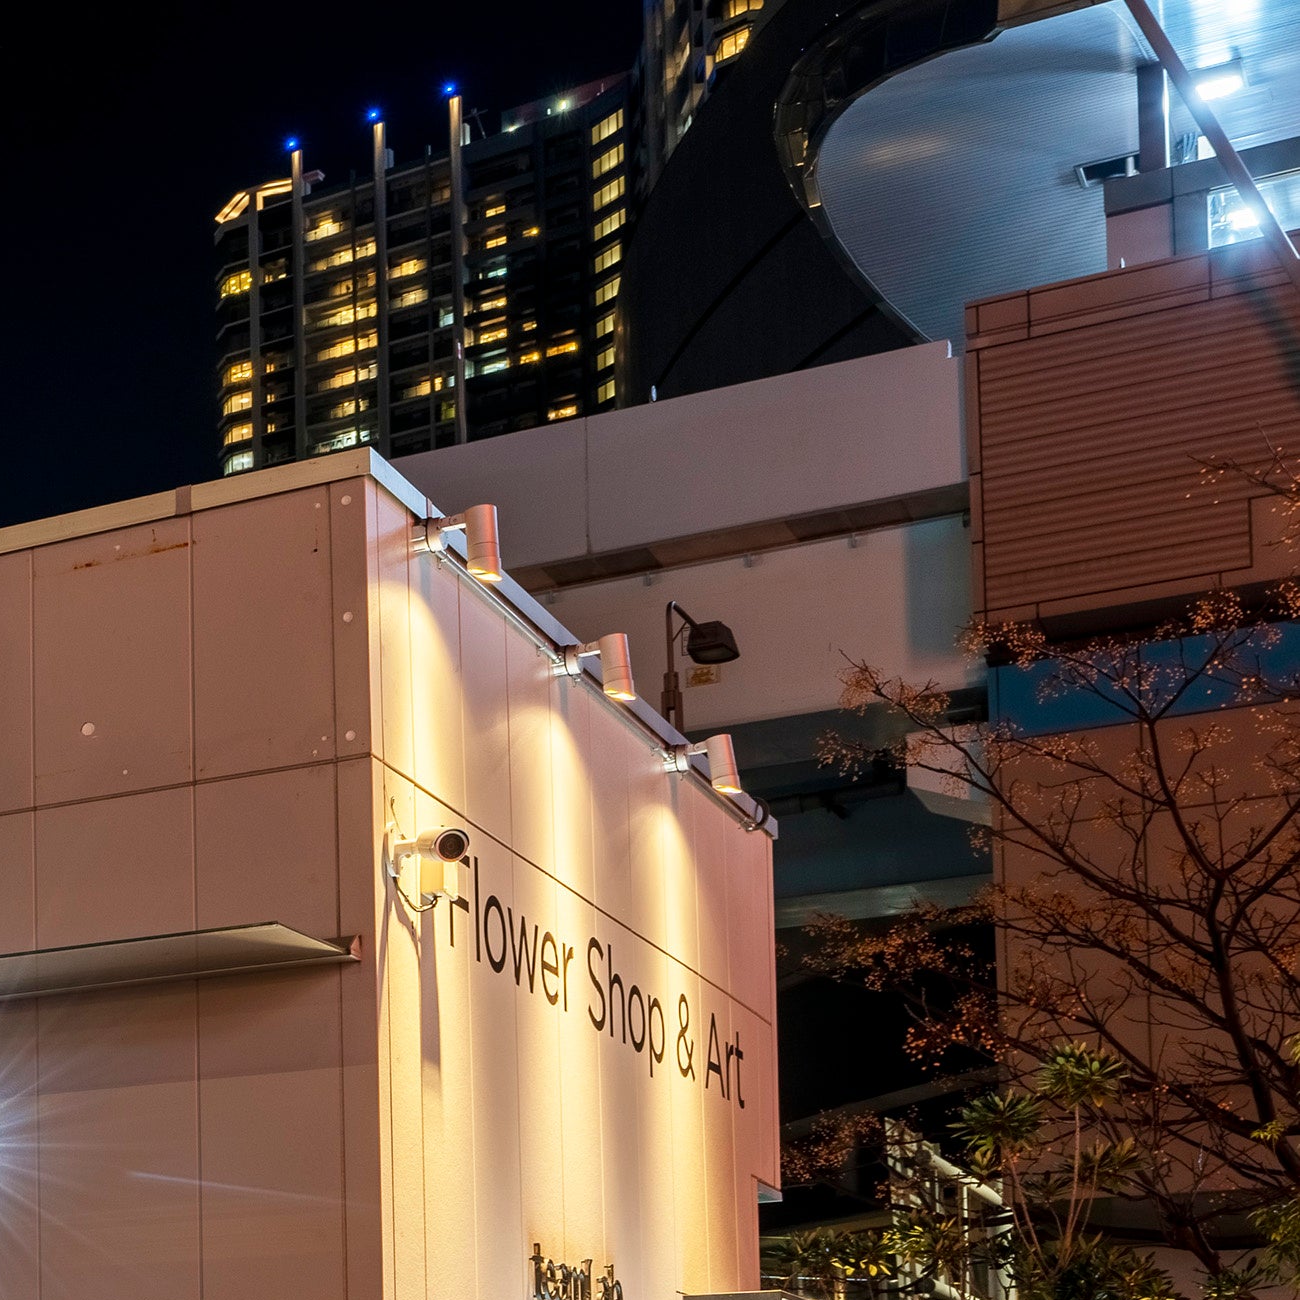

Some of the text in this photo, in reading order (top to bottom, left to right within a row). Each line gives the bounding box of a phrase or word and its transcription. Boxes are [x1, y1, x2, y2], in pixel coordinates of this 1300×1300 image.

[587, 936, 665, 1078] Shop
[676, 993, 696, 1081] &
[705, 1012, 745, 1109] Art
